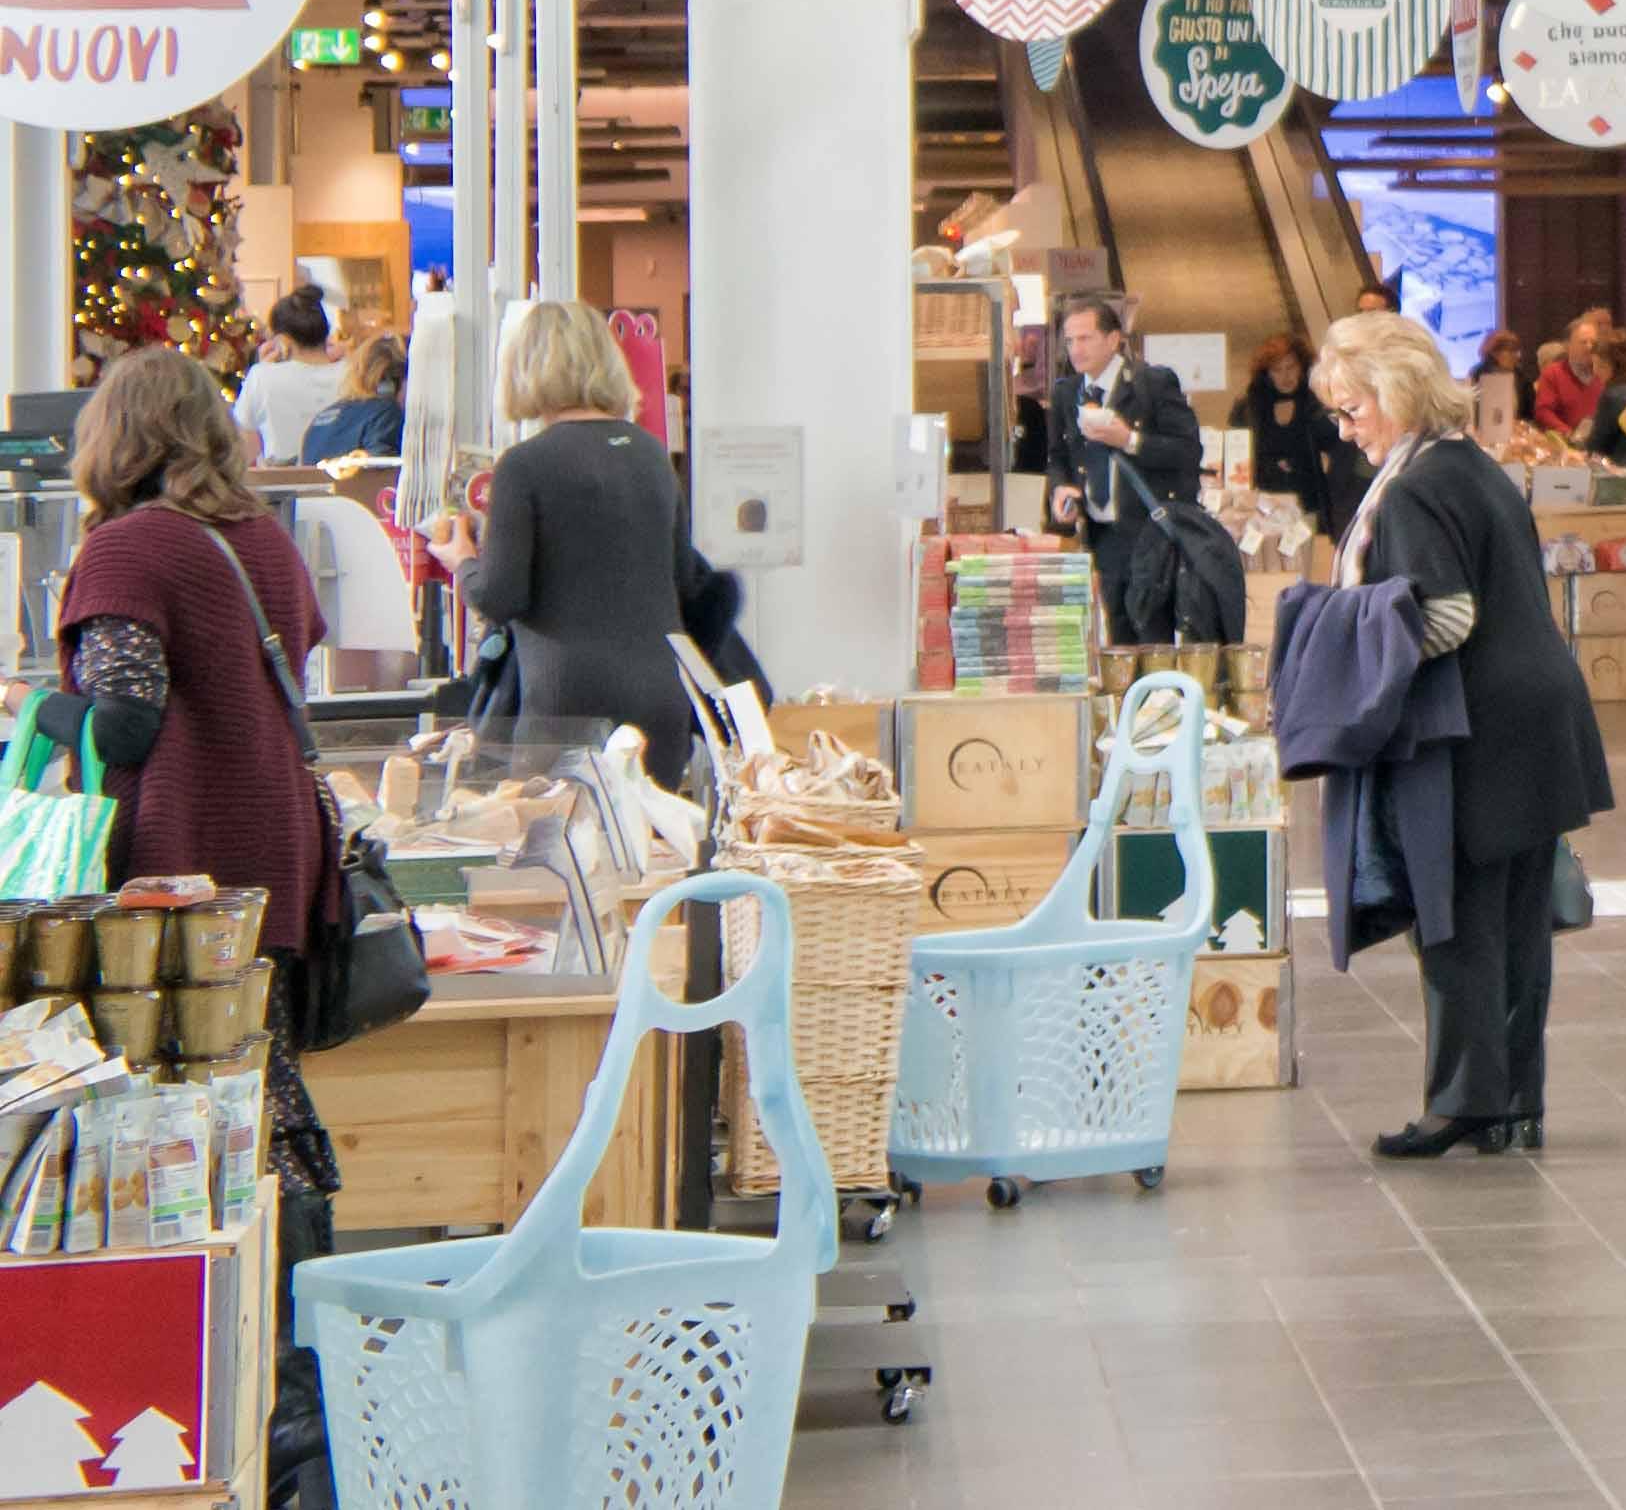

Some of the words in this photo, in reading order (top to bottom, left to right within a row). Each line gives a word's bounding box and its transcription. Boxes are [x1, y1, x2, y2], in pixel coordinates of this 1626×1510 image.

[1168, 15, 1222, 44] GIUSTO
[1226, 18, 1250, 42] UN
[0, 24, 179, 84] NUOVI
